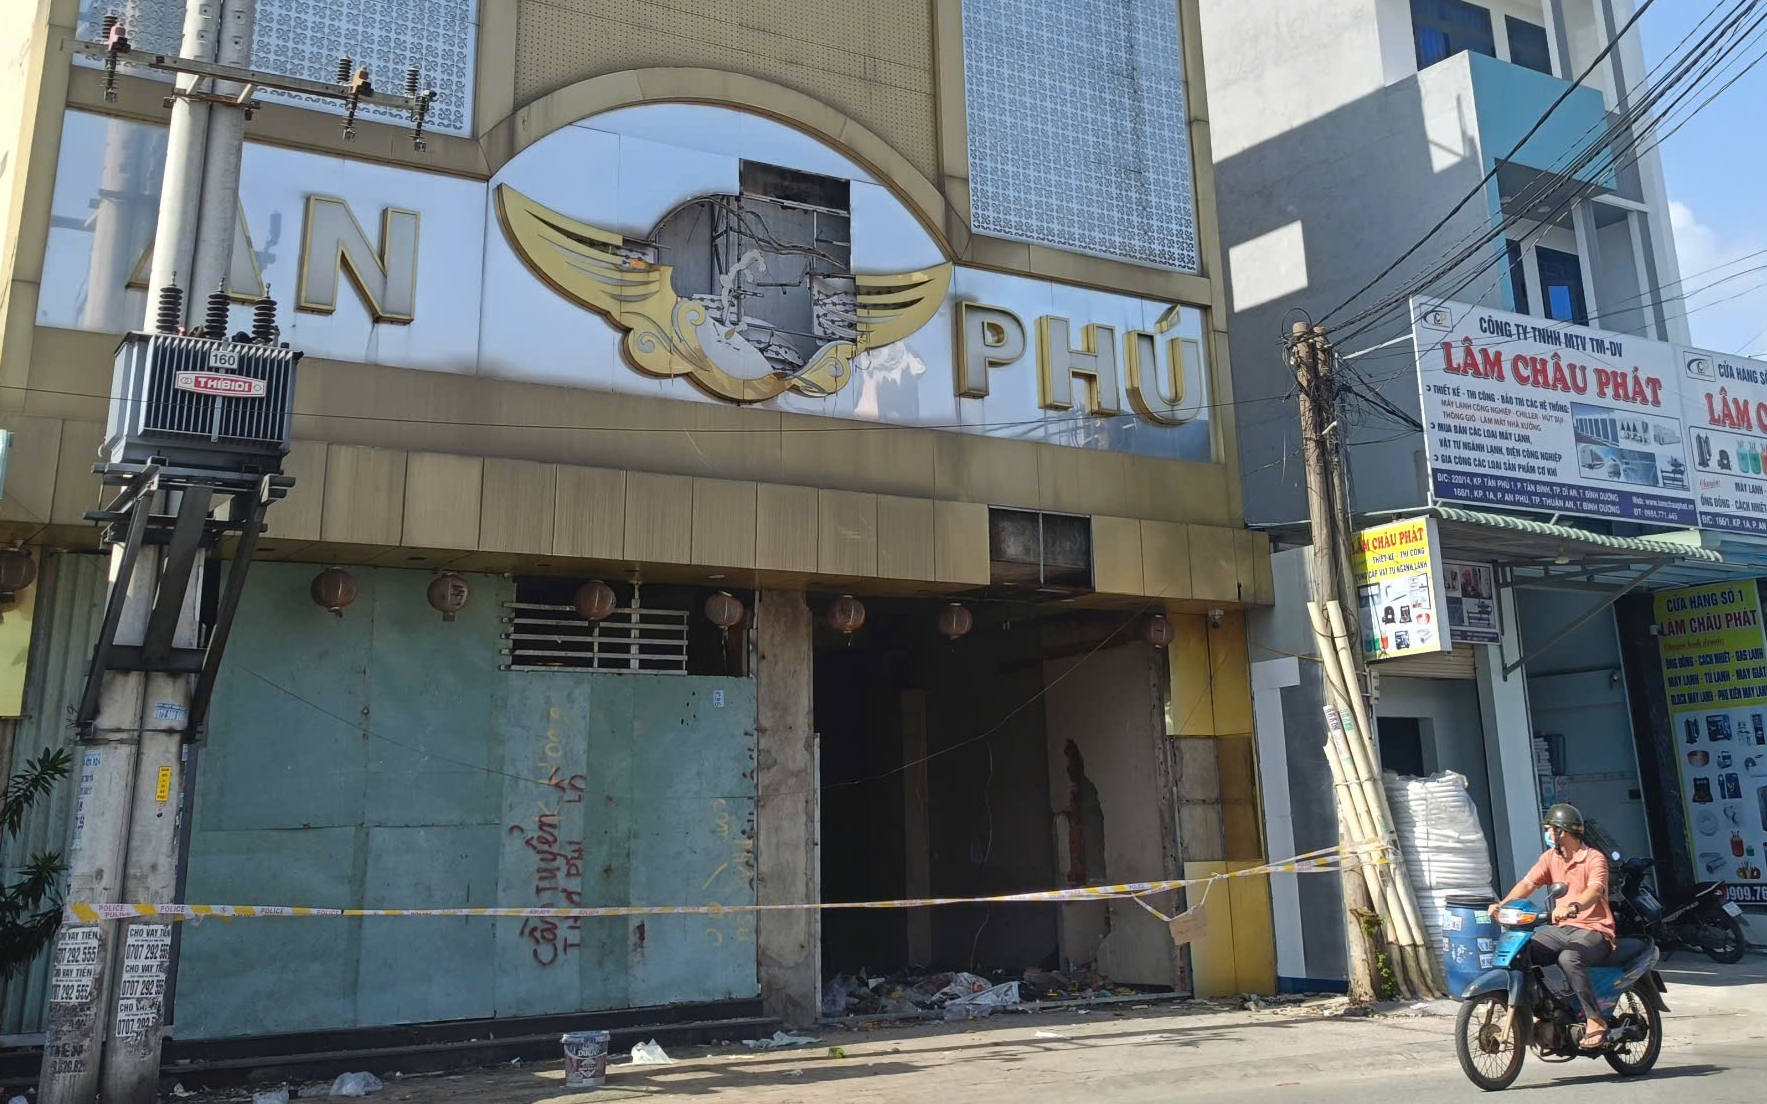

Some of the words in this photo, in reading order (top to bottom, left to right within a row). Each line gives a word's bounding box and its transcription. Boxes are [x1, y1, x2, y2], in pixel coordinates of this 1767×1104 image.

[1479, 315, 1512, 338] CÔNG
[1514, 324, 1531, 341] TY
[1531, 326, 1562, 347] TNHH
[1564, 332, 1587, 351] MTV
[1589, 337, 1622, 357] TM-DV
[212, 354, 235, 366] 160
[953, 302, 1202, 427] PHÚ
[1440, 336, 1505, 382] LÂM
[1511, 352, 1587, 395] CHÂU
[1593, 366, 1662, 407] PHÁT
[1718, 360, 1735, 380] CỬA
[1736, 366, 1758, 384] HÀNG
[1433, 384, 1450, 396] THIẾT
[1452, 385, 1461, 397] KẾ
[1466, 390, 1477, 399] THI
[1478, 390, 1496, 402] CÔNG
[1526, 398, 1538, 409] CÁC
[1539, 400, 1547, 412] HỆ
[1473, 403, 1490, 413] CÔNG
[1705, 385, 1753, 431] LÂM
[1437, 423, 1452, 433] MUA
[1454, 424, 1467, 435] BÁN
[1468, 426, 1482, 437] CÁC
[1483, 429, 1498, 440] LOẠI
[1499, 430, 1512, 440] MÁY
[1439, 437, 1451, 450] VẬT
[1463, 441, 1485, 453] NGÀNH
[1522, 448, 1539, 460] CÔNG
[1441, 454, 1452, 465] GIA
[1454, 455, 1472, 467] CÔNG
[1473, 457, 1487, 468] CÁC
[1487, 460, 1502, 472] LOẠI
[1503, 460, 1517, 472] SẢN
[1484, 477, 1496, 487] TÂN
[1523, 482, 1536, 492] TÂN
[1504, 493, 1514, 501] AN
[1372, 531, 1396, 550] CHÂU
[1398, 525, 1424, 546] PHÁT
[1667, 593, 1687, 612] CỬA
[1690, 589, 1717, 609] HÀNG
[1720, 586, 1736, 604] SỐ
[1738, 589, 1744, 602] 1
[1660, 616, 1686, 637] LÂM
[1690, 612, 1722, 633] CHÂU
[1725, 607, 1757, 629] PHÁT
[99, 904, 125, 912] POLICE
[160, 905, 185, 913] POLICE
[67, 931, 80, 941] VAY
[130, 928, 144, 937] CHO
[146, 928, 158, 937] VAY
[67, 947, 81, 963] 292
[82, 946, 97, 963] 555
[126, 944, 144, 960] 0707
[145, 944, 159, 960] 292
[62, 968, 74, 977] VAY
[125, 964, 139, 973] CHO
[141, 964, 154, 973] VAY
[61, 984, 75, 1000] 292
[75, 984, 90, 1000] 555
[122, 980, 140, 996] 0707
[140, 980, 155, 996] 292
[120, 1003, 134, 1012] CHO
[117, 1019, 135, 1036] 0707
